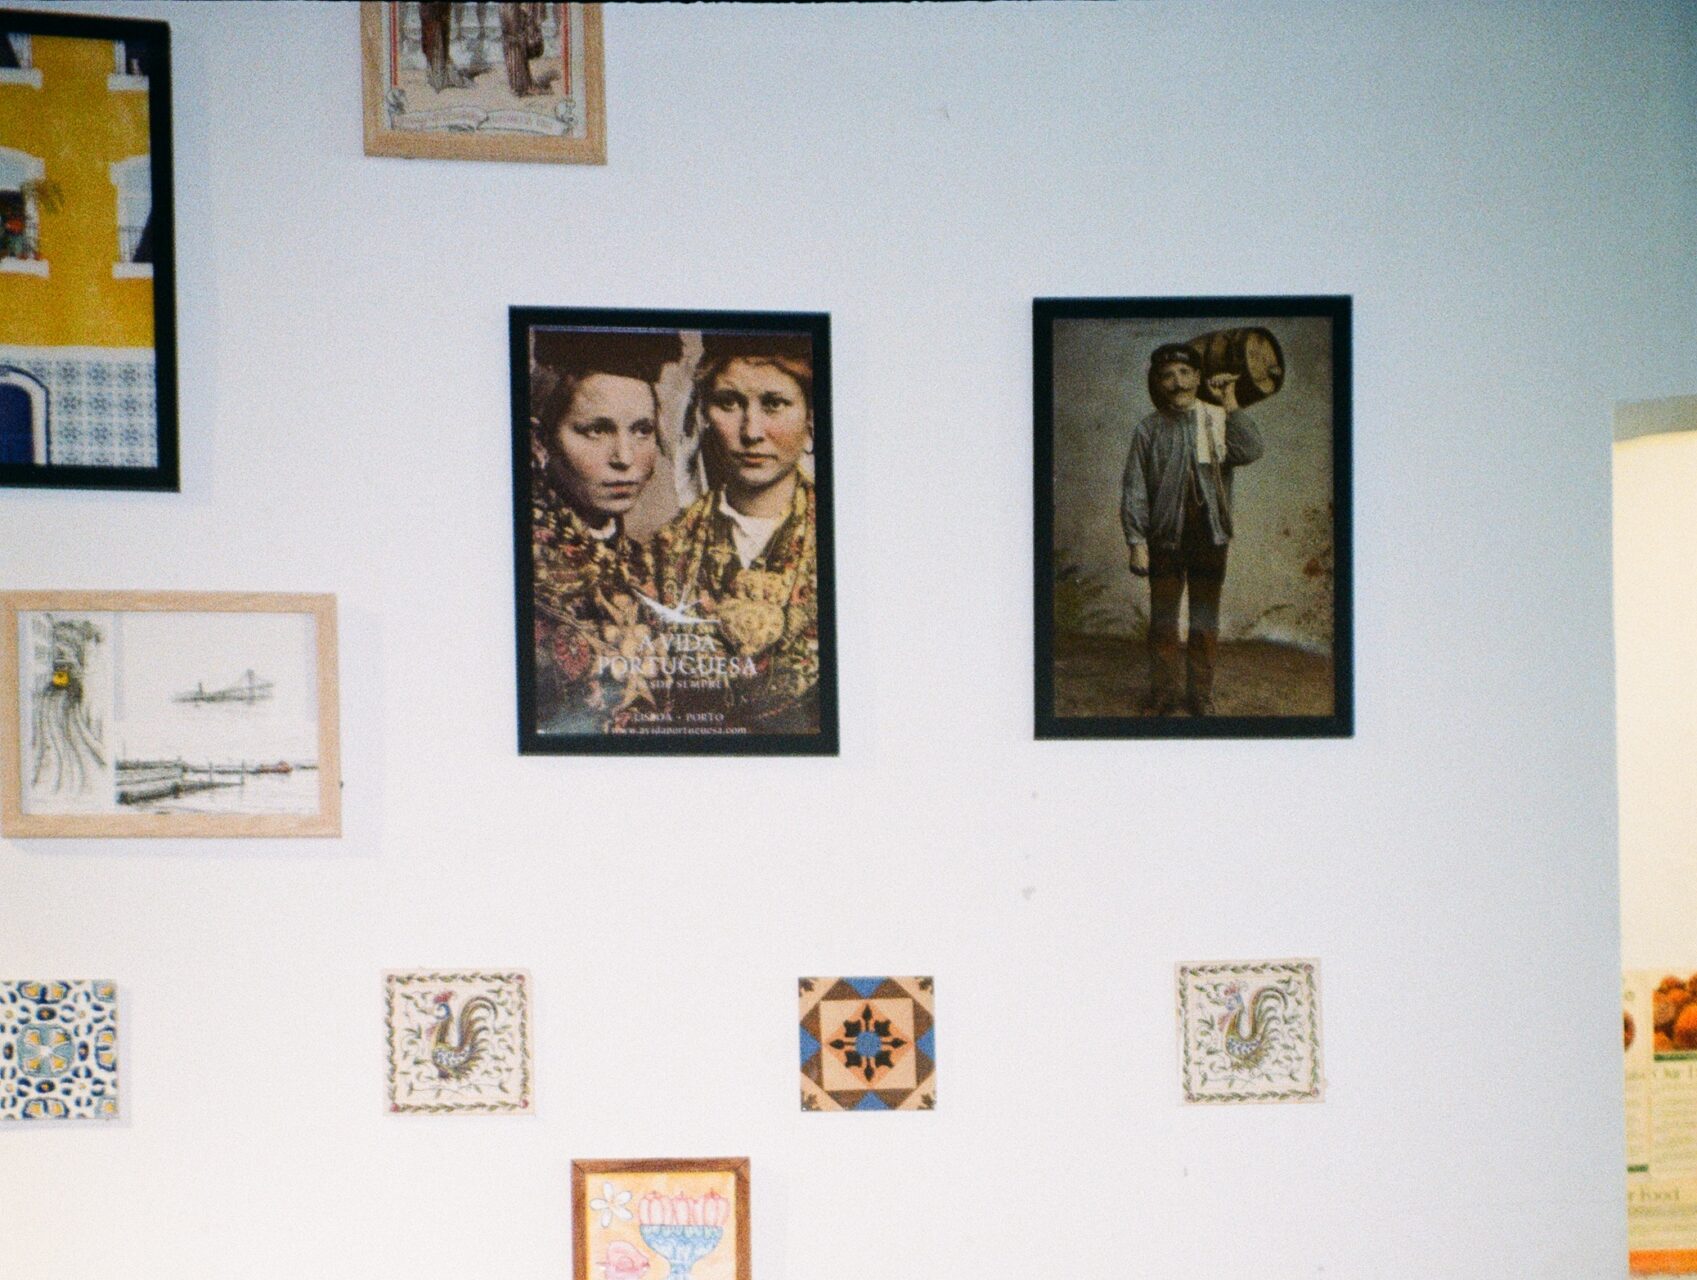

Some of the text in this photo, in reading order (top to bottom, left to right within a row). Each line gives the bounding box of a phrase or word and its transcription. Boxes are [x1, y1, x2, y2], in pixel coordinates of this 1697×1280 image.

[638, 633, 717, 652] A VIDA
[598, 655, 757, 677] PORTUGUESA
[686, 712, 725, 723] PORTO
